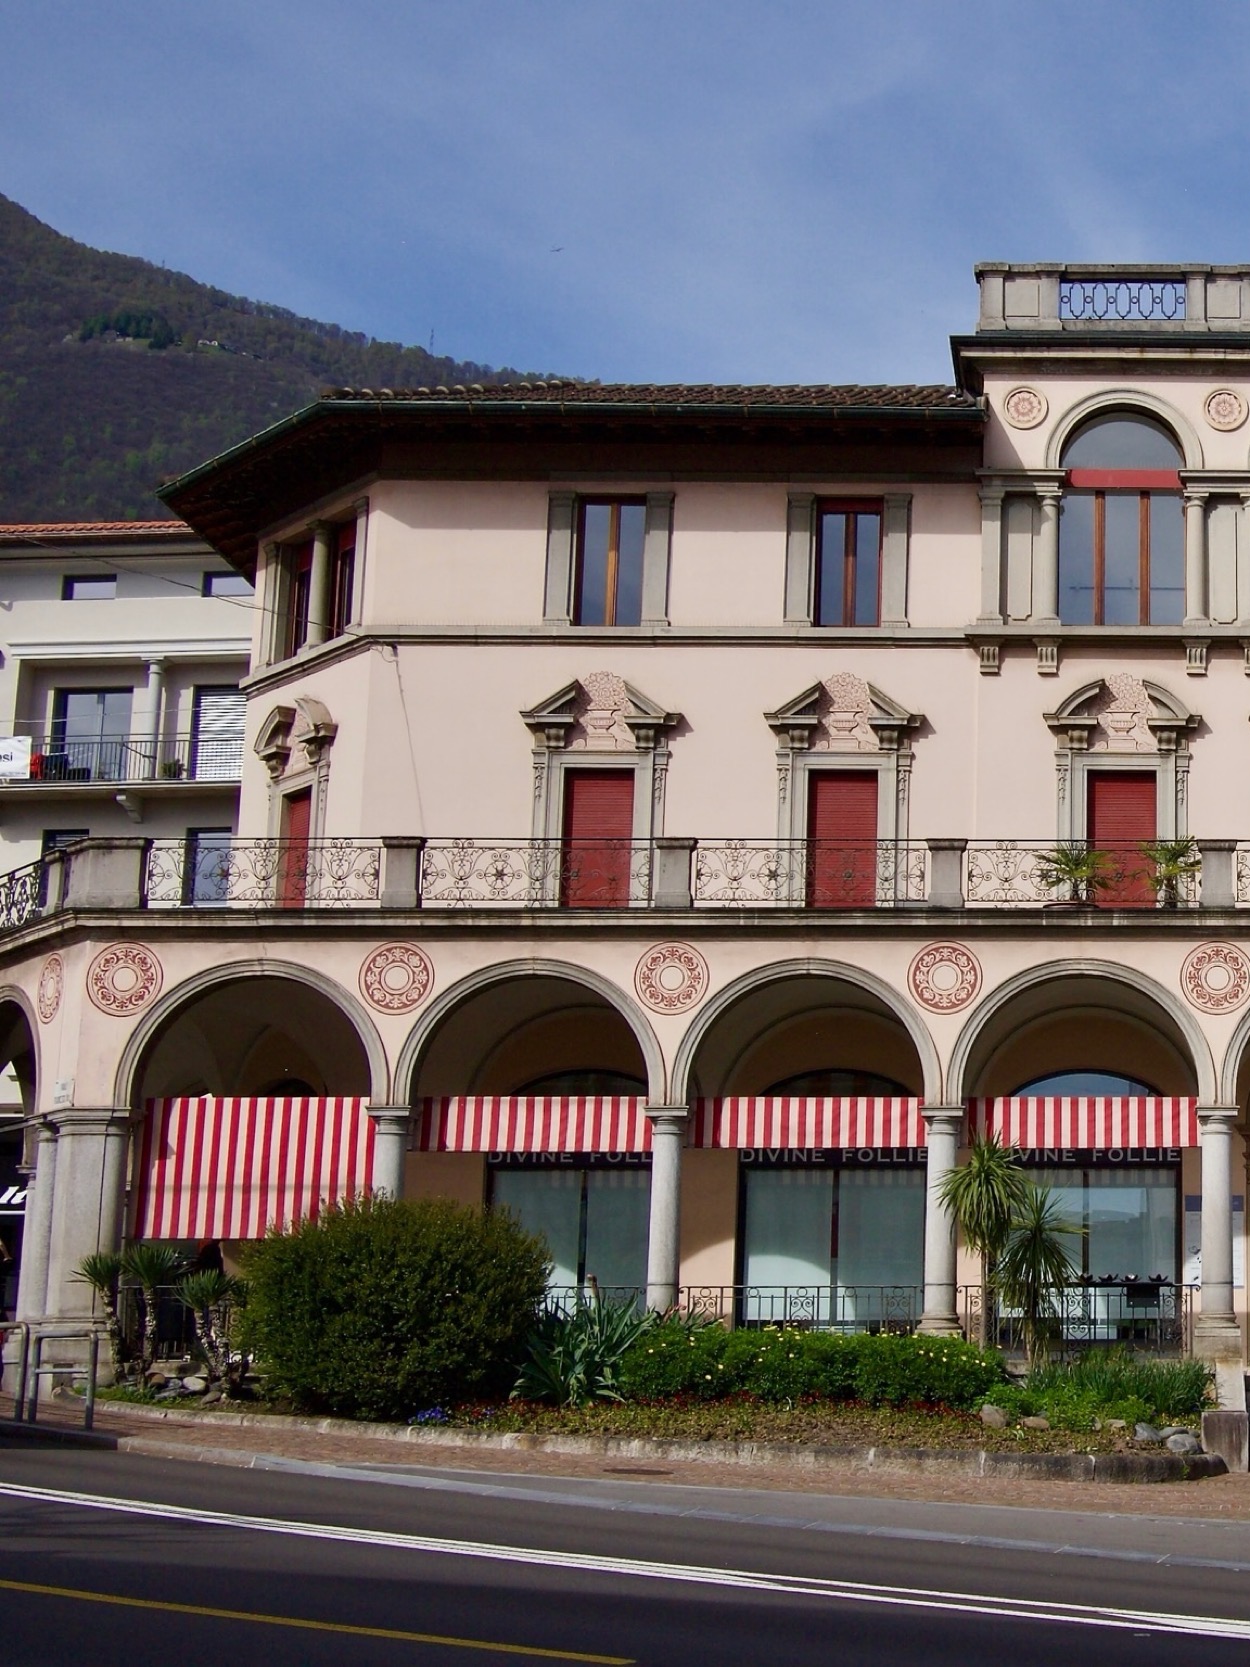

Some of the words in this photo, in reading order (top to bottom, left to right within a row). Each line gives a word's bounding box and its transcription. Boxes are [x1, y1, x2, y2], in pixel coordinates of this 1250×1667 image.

[488, 1152, 574, 1163] DIVINE
[740, 1148, 826, 1162] DIVINE
[842, 1148, 928, 1162] FOLLIE
[1092, 1147, 1181, 1162] FOLLIE
